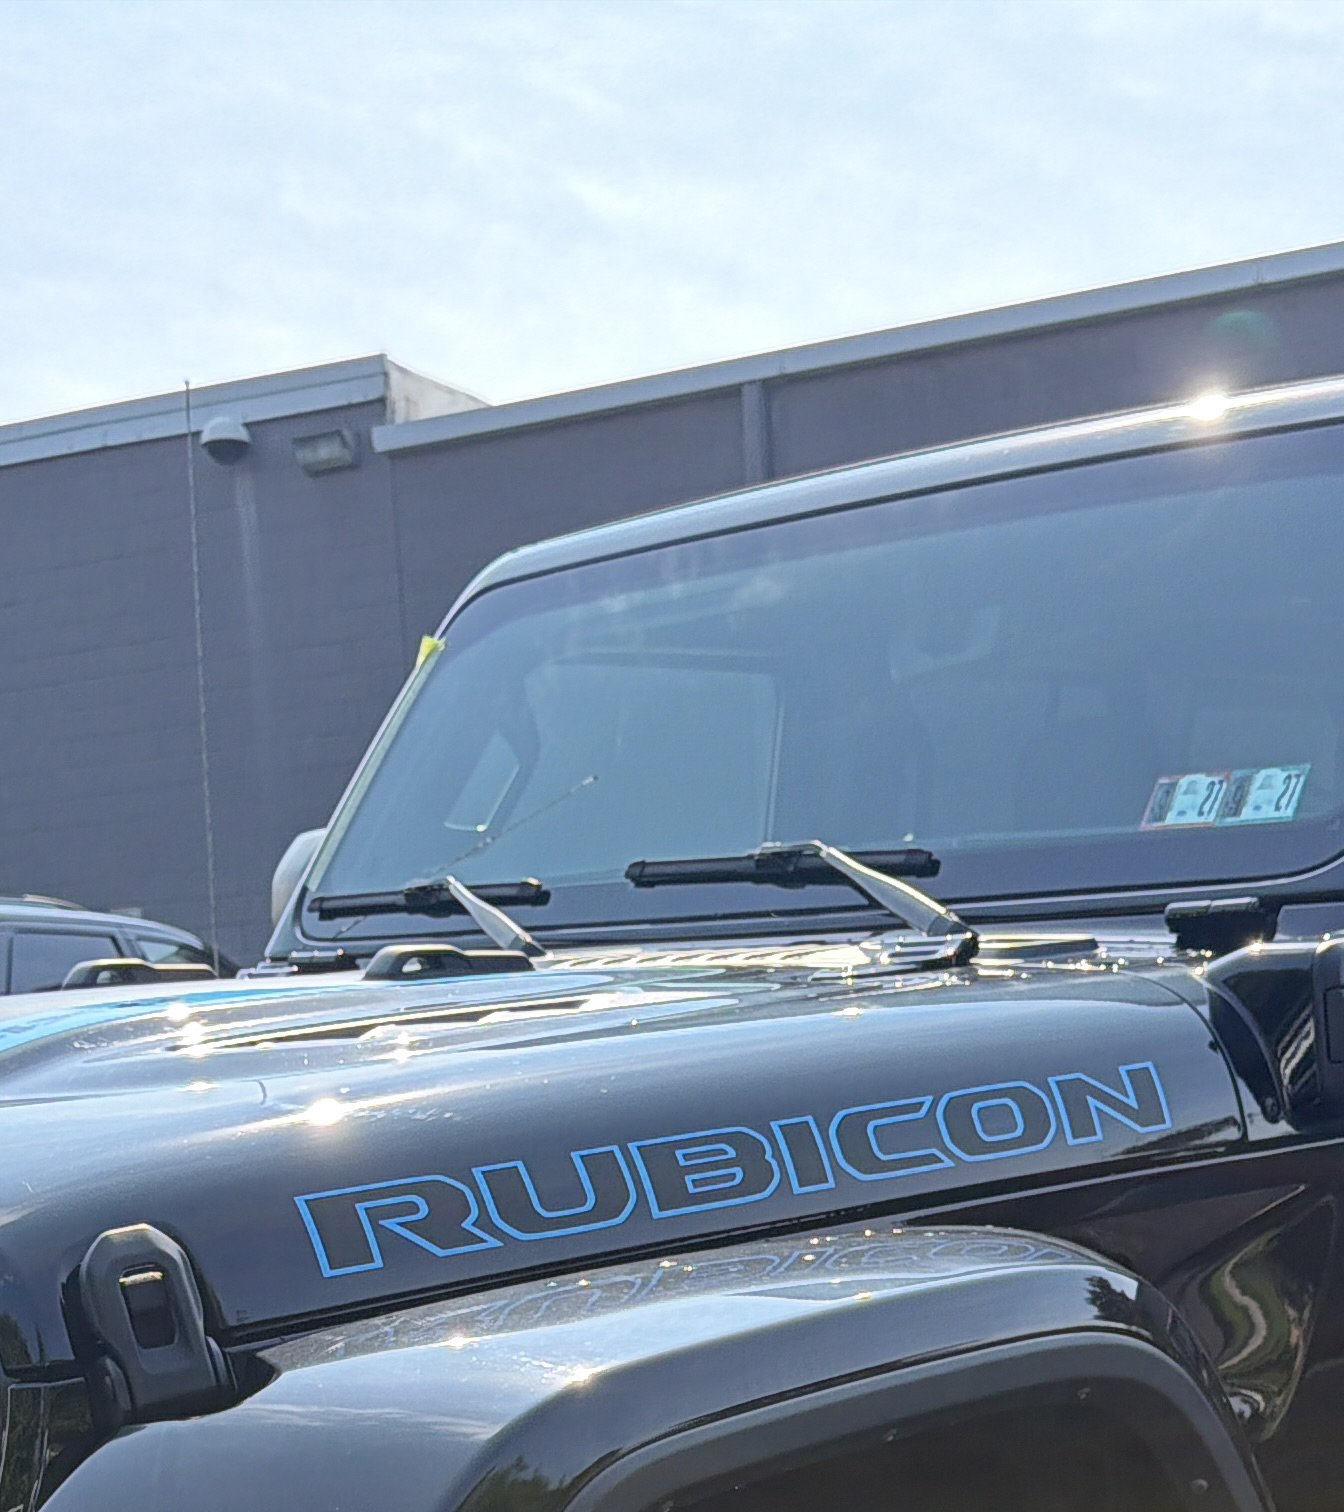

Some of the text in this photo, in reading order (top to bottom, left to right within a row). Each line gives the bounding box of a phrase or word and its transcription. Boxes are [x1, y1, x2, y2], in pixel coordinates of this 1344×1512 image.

[1197, 780, 1225, 817] 27
[1274, 773, 1302, 812] 27
[293, 1061, 1172, 1278] RUBICON
